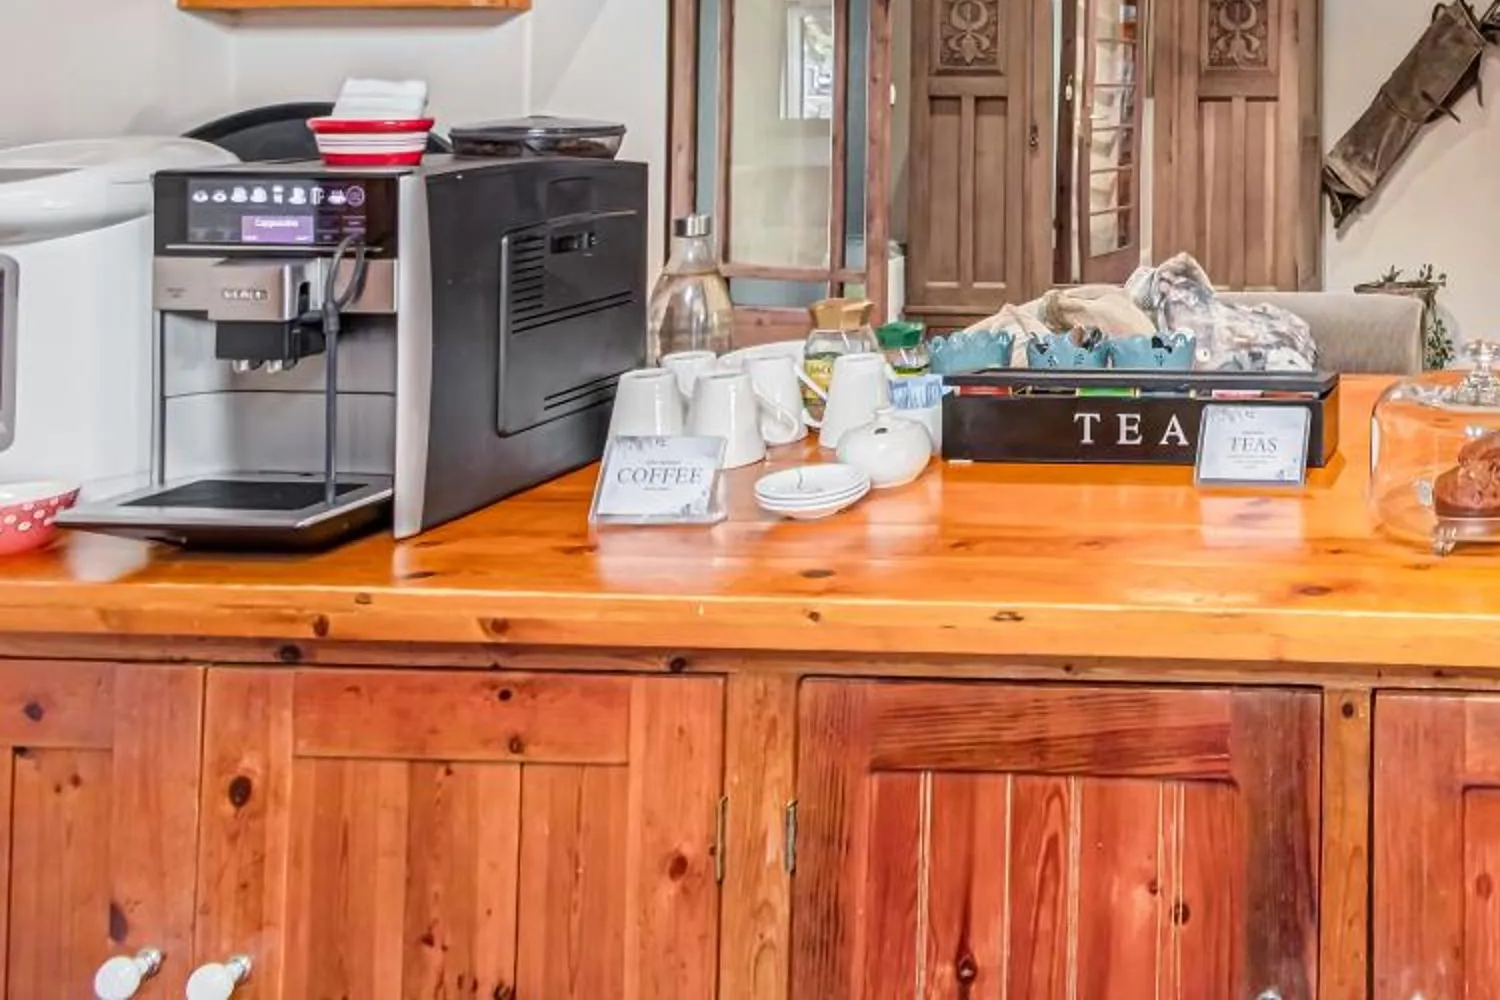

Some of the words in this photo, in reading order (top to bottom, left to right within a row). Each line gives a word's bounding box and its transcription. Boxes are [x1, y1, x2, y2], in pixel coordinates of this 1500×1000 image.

[1073, 412, 1190, 446] TEA
[1228, 436, 1279, 454] TEAS
[617, 467, 703, 484] COFFEE
